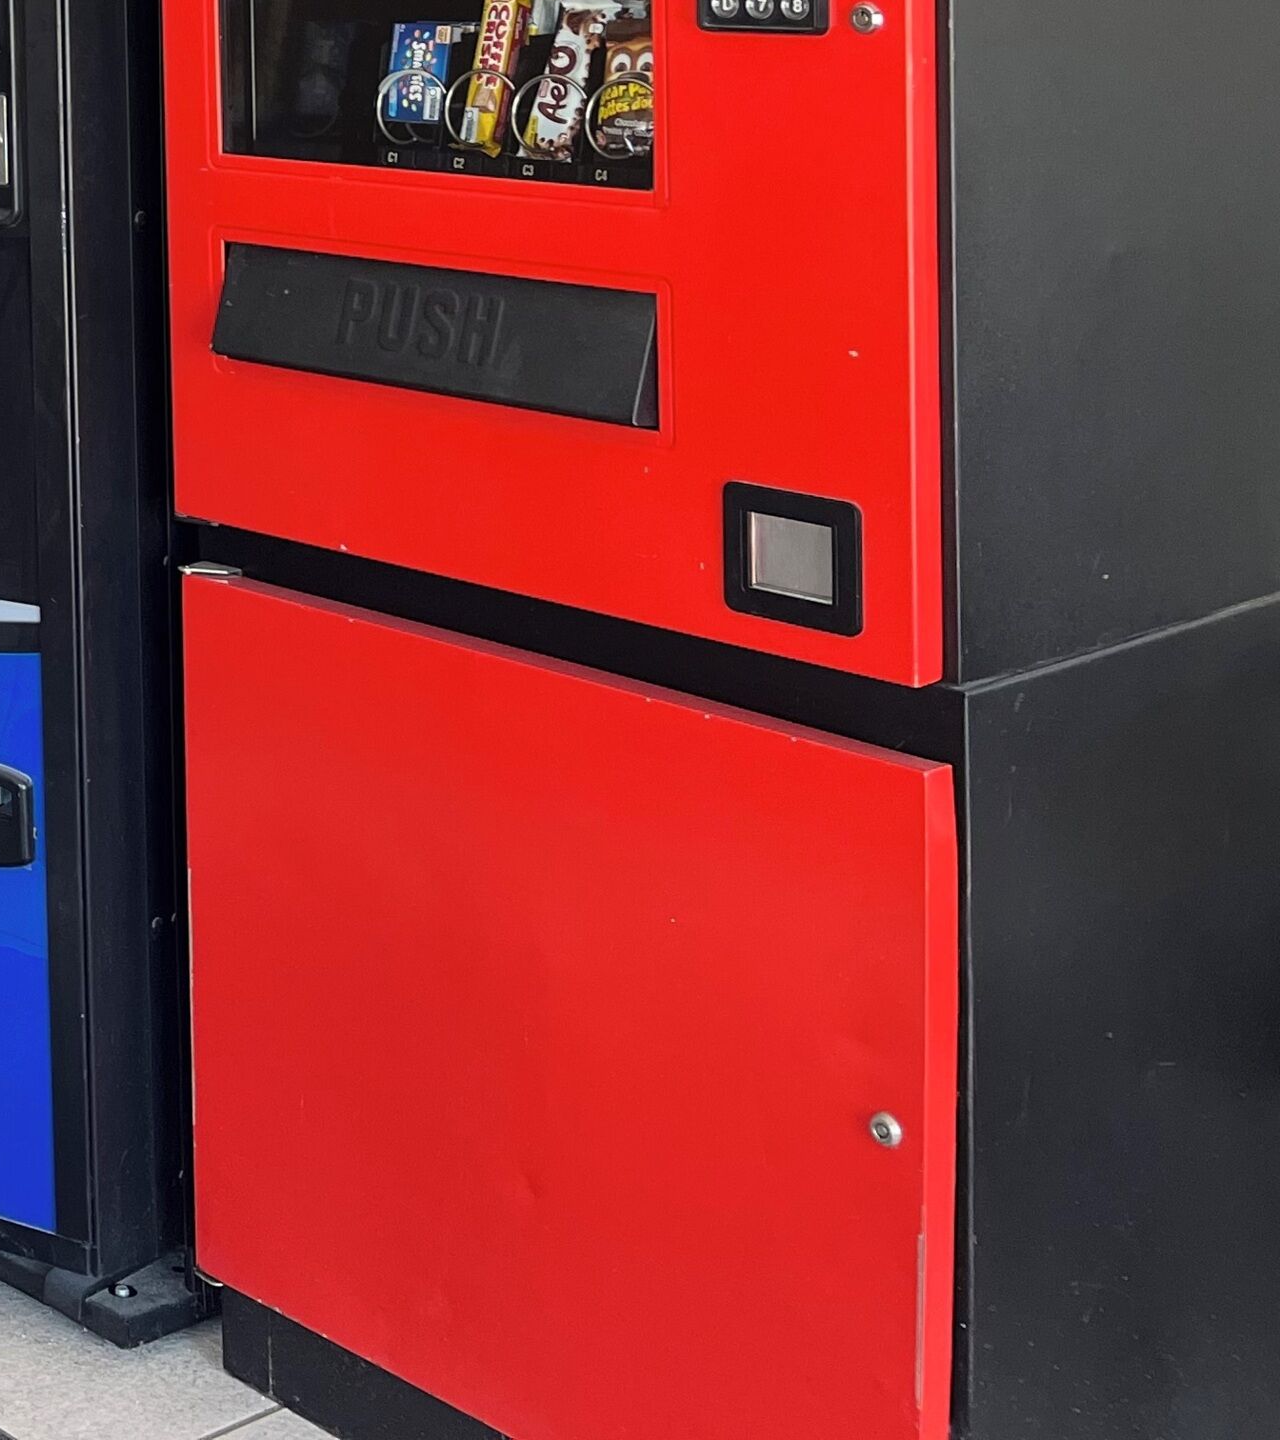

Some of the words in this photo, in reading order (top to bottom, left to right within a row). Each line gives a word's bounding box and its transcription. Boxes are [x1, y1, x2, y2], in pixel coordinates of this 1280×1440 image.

[485, 4, 510, 87] COFFEE
[408, 40, 427, 101] SMATIES
[387, 152, 398, 163] C1
[453, 158, 465, 169] C2
[522, 165, 534, 177] C3
[595, 170, 608, 181] C4
[335, 275, 505, 367] PUSH
